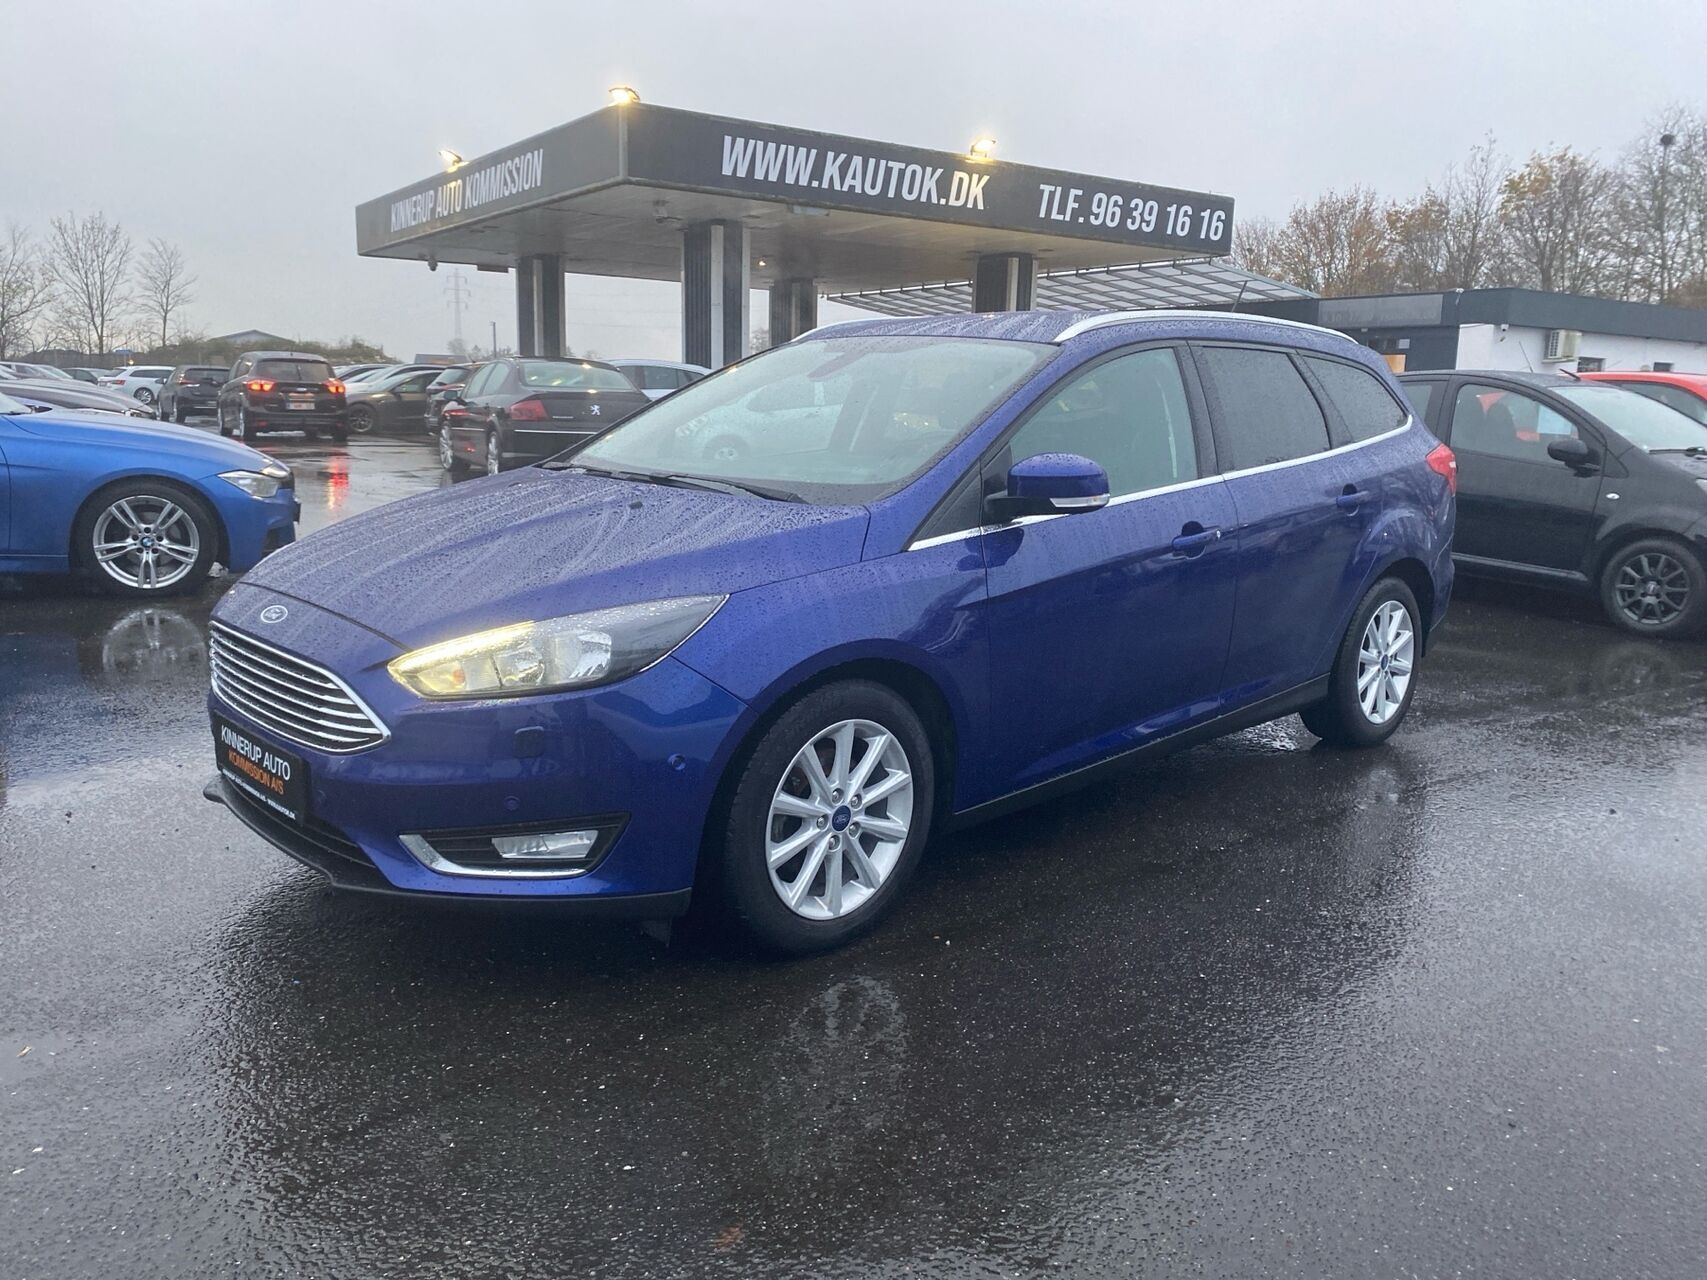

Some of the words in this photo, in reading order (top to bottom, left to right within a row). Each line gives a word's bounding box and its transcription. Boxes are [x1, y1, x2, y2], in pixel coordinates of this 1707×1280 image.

[391, 190, 435, 232] KINNERUP
[436, 179, 462, 218] AUTO
[465, 148, 544, 209] KOMMISSION
[721, 135, 990, 210] WWW.KAUTOK.DK
[1038, 184, 1085, 223] TLF.
[1089, 192, 1124, 228] 96
[1126, 198, 1159, 233] 39
[1166, 204, 1193, 237] 16
[1200, 208, 1226, 241] 16
[221, 725, 262, 763] KINNERUP
[263, 751, 291, 781] AUTO
